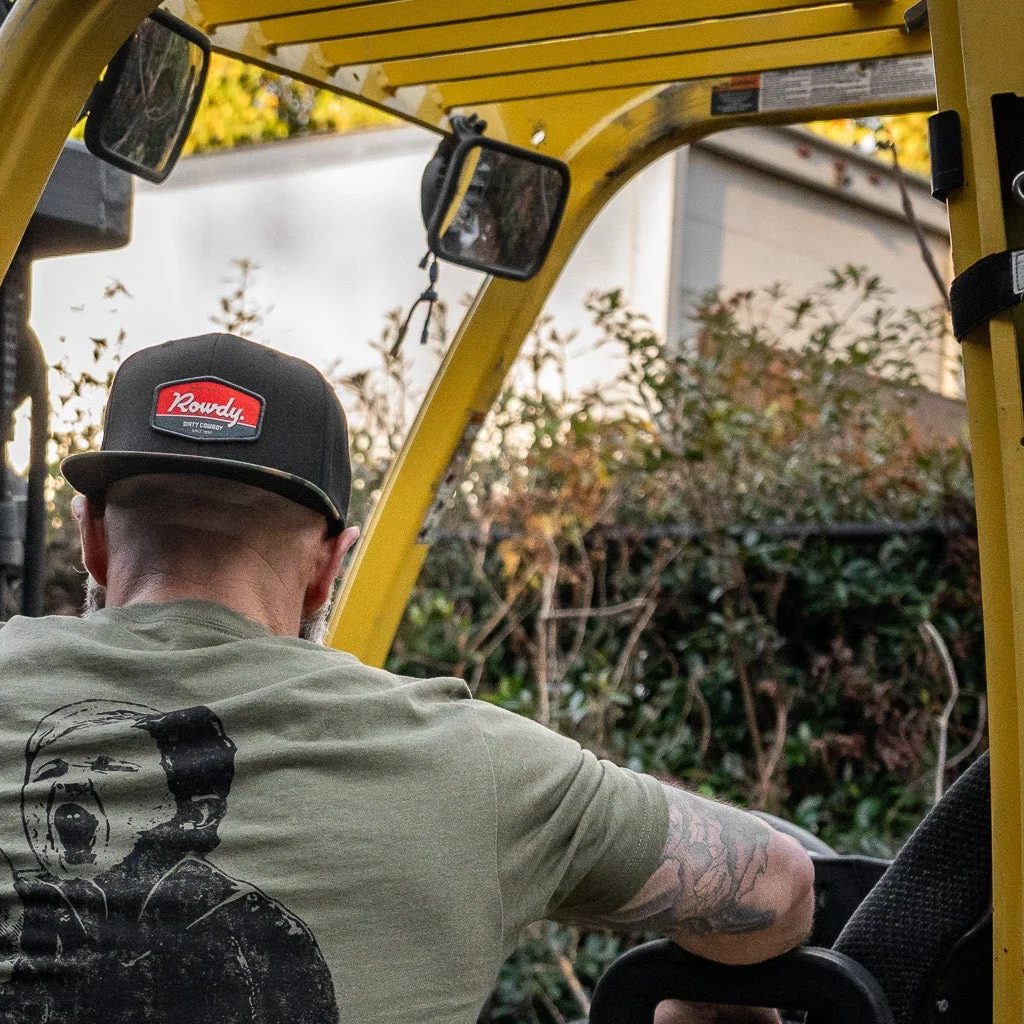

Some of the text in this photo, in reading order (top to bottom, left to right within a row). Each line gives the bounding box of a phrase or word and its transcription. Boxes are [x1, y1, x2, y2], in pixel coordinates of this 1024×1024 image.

[167, 392, 245, 428] Rowdy.
[182, 420, 224, 431] DIRTY COWBOY
